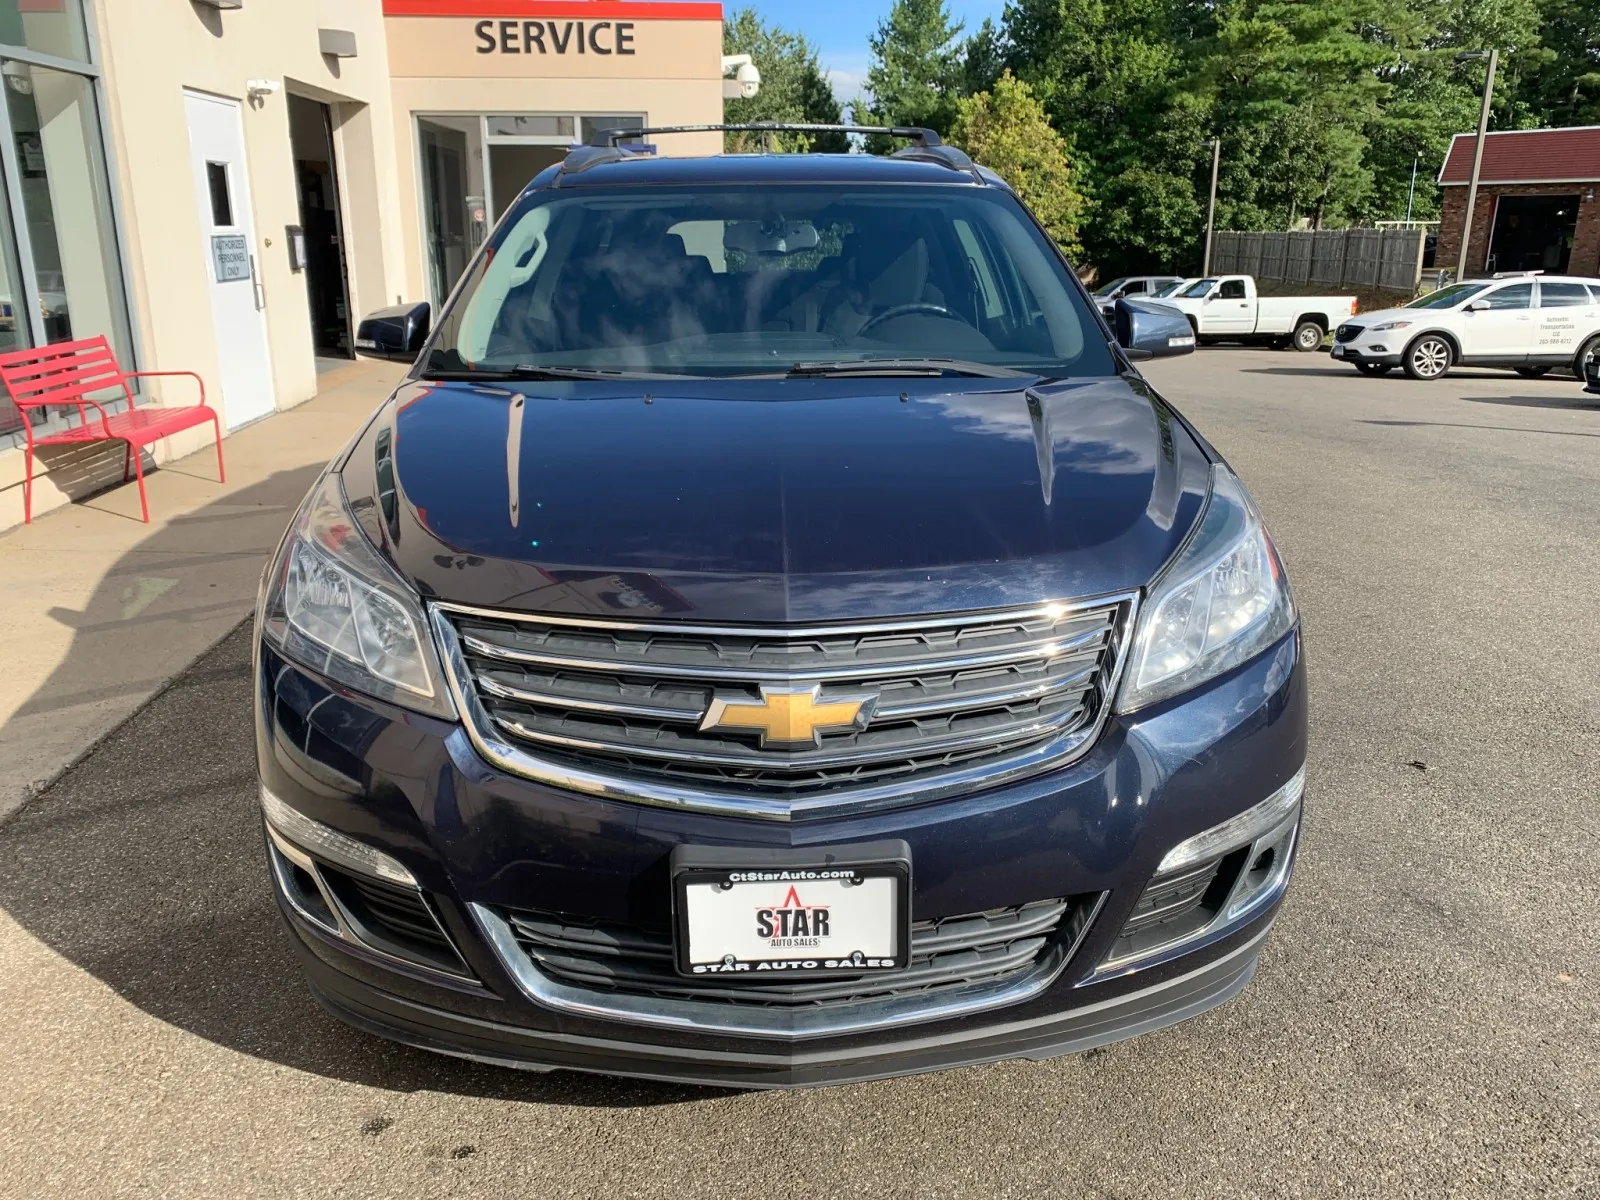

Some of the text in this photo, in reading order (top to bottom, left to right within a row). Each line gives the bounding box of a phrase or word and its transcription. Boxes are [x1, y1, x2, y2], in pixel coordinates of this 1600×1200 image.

[475, 20, 636, 55] SERVICE
[216, 239, 244, 250] AUTHORIZED
[218, 252, 245, 263] PERSONNEL
[227, 266, 240, 276] ONLY
[729, 870, 854, 882] CtStarAuto.com
[756, 909, 830, 938] STAR
[770, 938, 819, 947] AUTO SALES
[692, 958, 895, 974] STAR AUTO SALES
